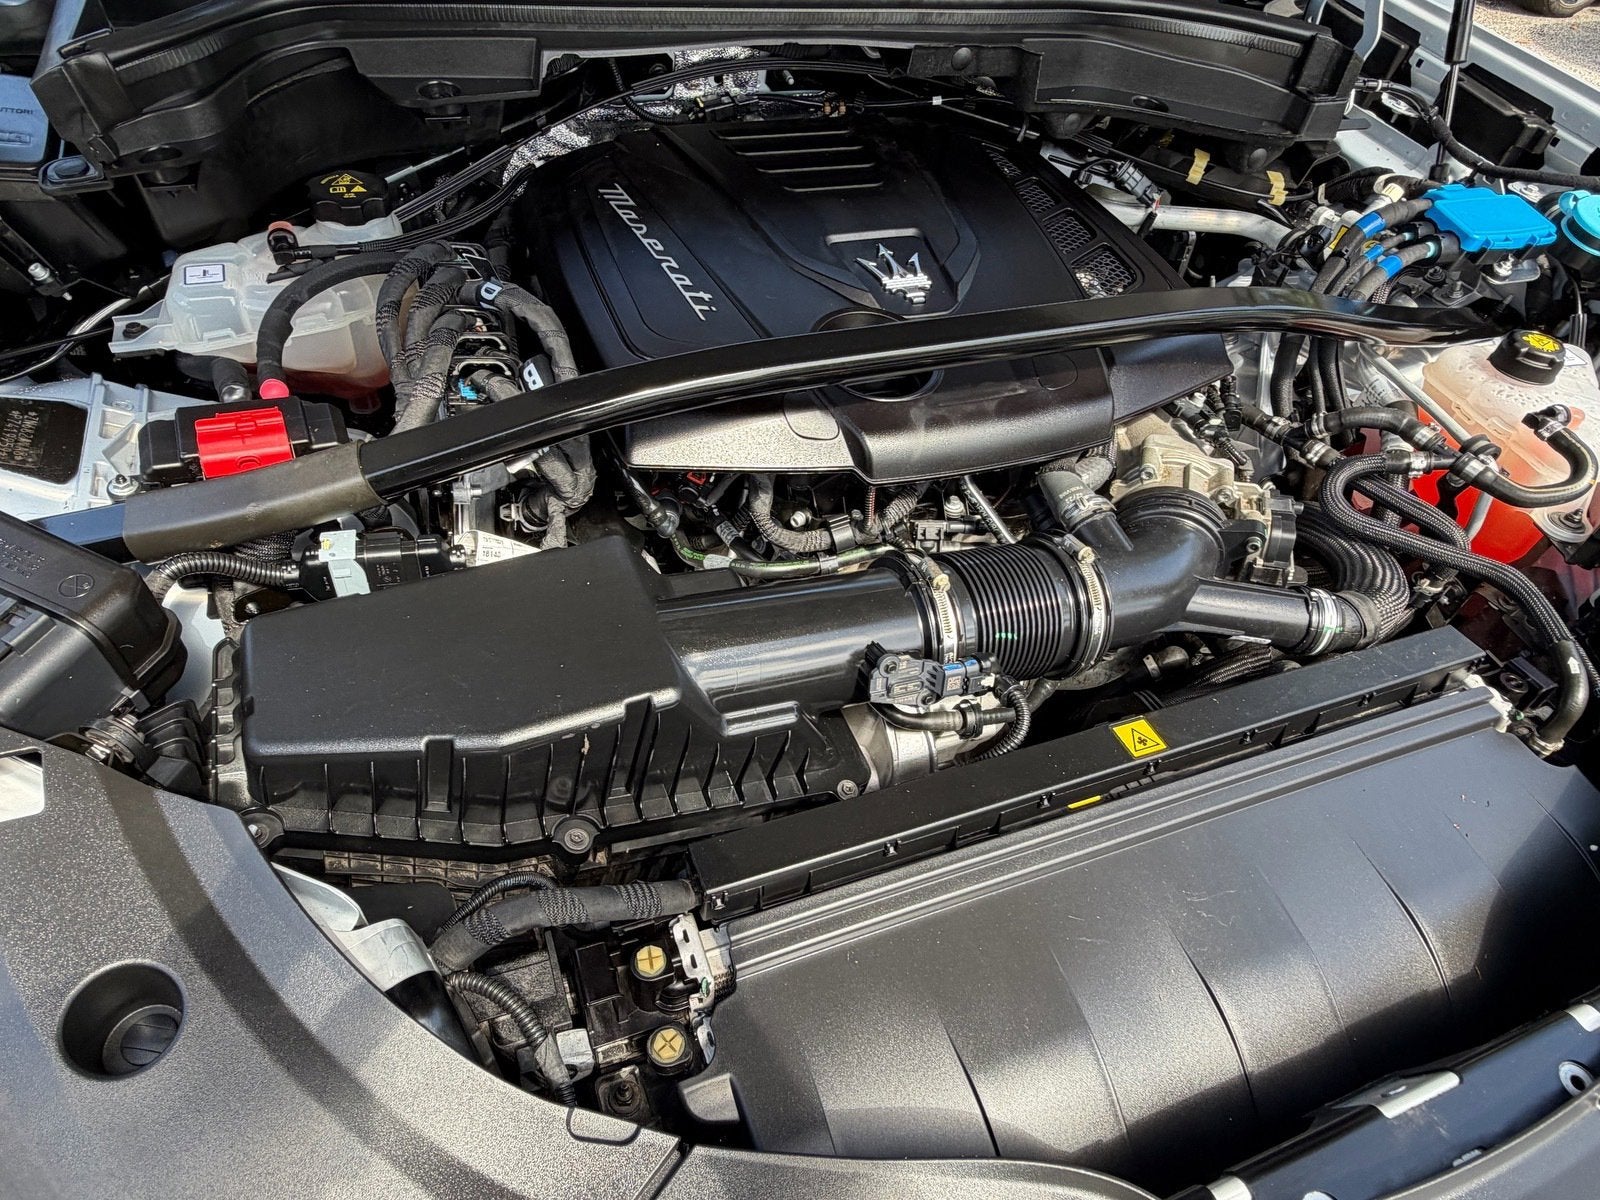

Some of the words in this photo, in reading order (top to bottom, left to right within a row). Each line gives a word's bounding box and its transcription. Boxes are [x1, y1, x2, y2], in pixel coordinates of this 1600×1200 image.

[598, 182, 717, 321] Maserati
[480, 281, 503, 301] D
[523, 362, 545, 391] B
